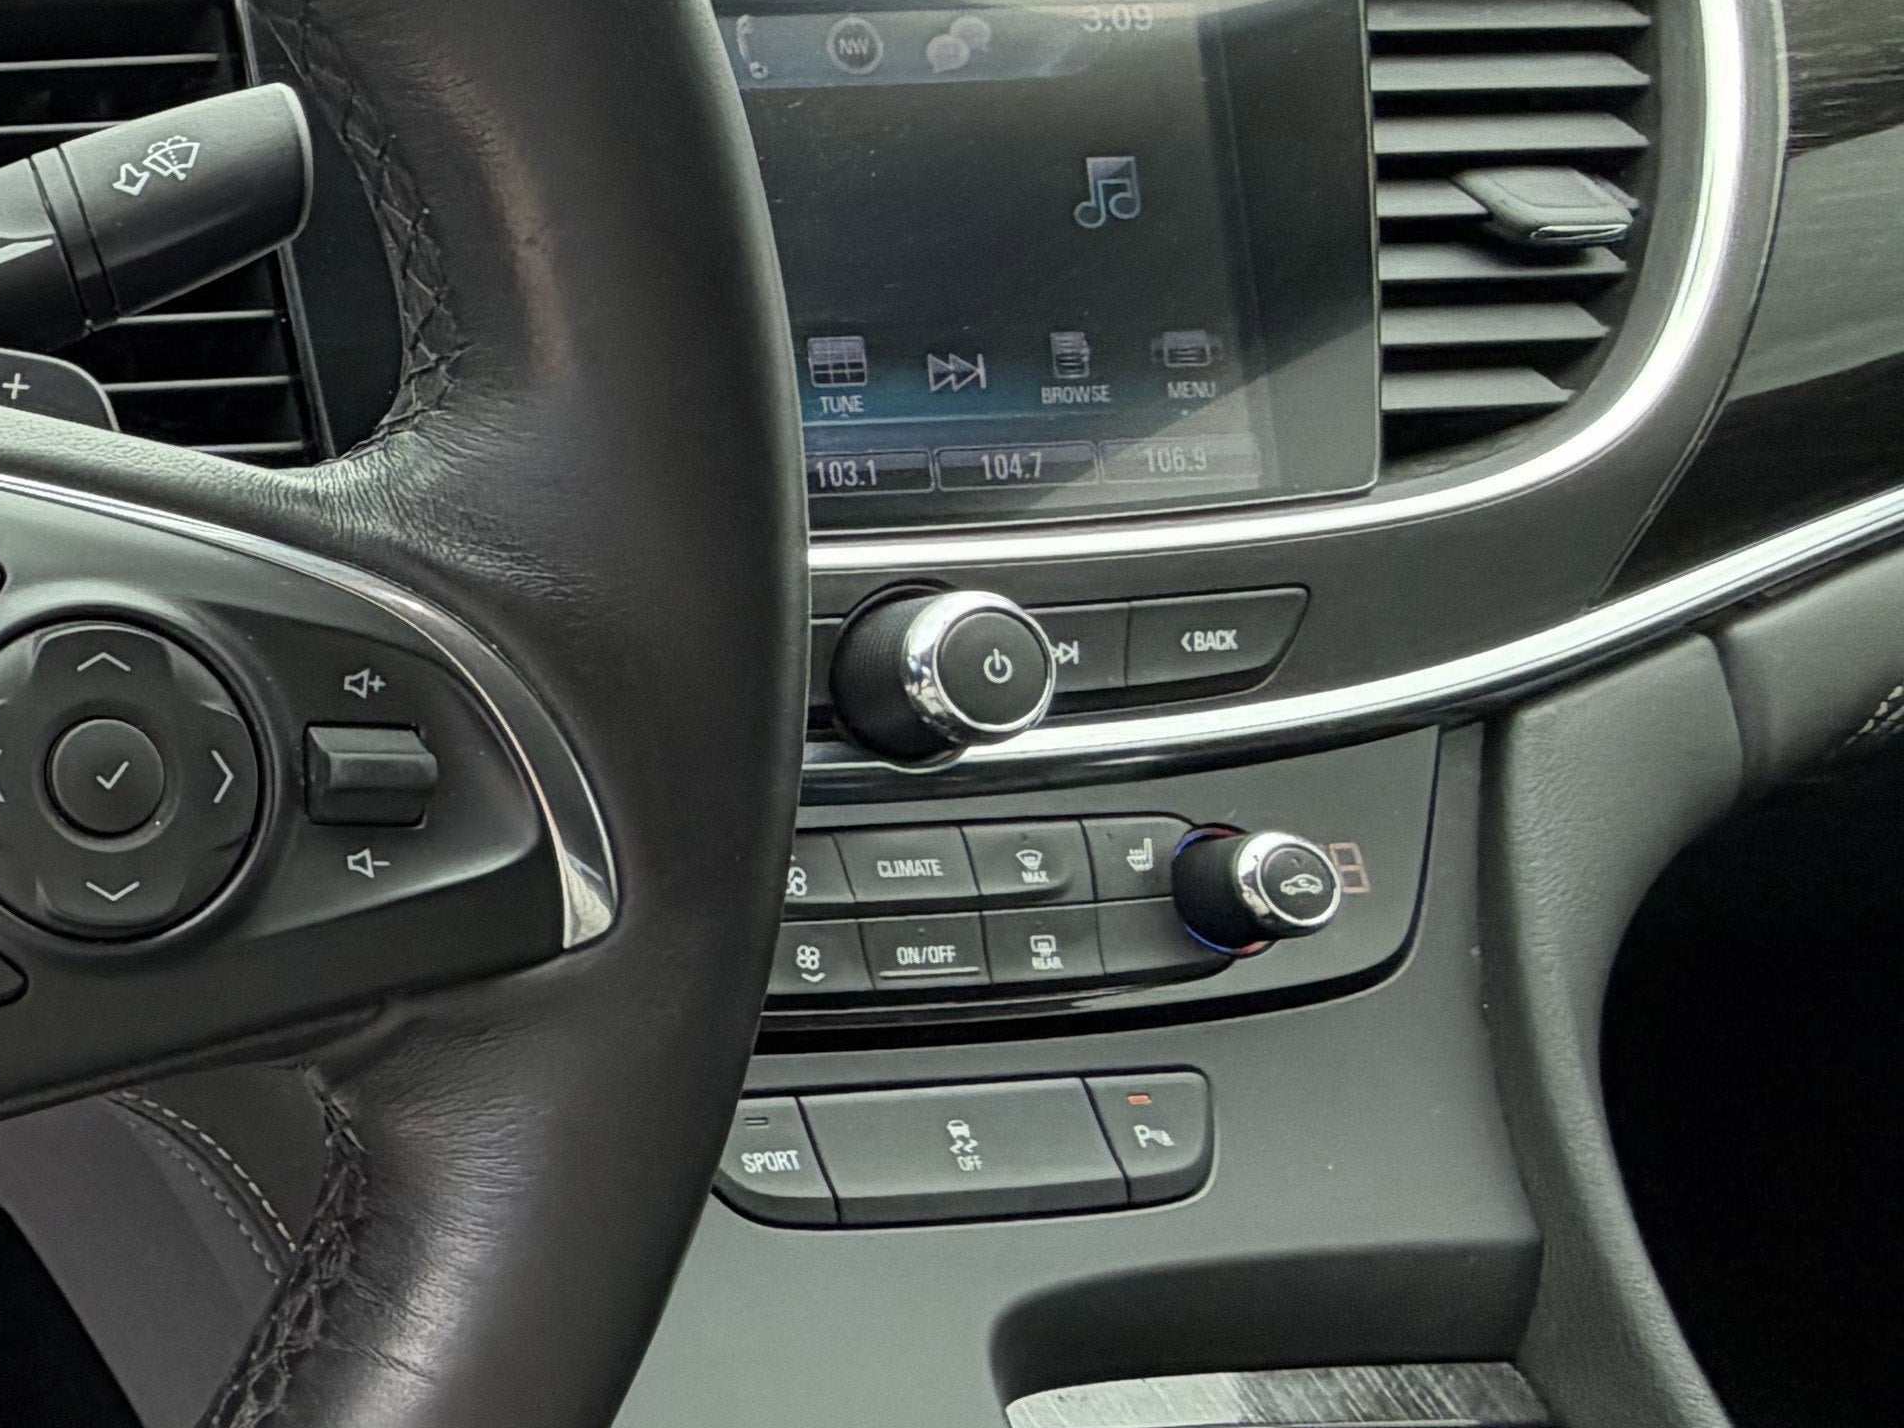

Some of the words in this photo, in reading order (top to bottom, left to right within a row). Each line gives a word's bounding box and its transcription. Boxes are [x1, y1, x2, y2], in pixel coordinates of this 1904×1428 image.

[1082, 4, 1154, 32] 3:09
[839, 37, 869, 56] NW
[1041, 383, 1111, 404] BROWSE
[1168, 381, 1217, 400] MENU
[819, 395, 864, 413] TUNE
[981, 451, 1044, 481] 104.7
[1144, 446, 1208, 474] 106.9
[815, 459, 879, 488] 103.1
[877, 858, 944, 878] CLIMATE
[1022, 871, 1050, 884] MAX
[896, 945, 956, 965] ON/OFF
[1031, 956, 1064, 971] REAR
[741, 1149, 801, 1174] SPORT
[957, 1154, 983, 1172] OFF
